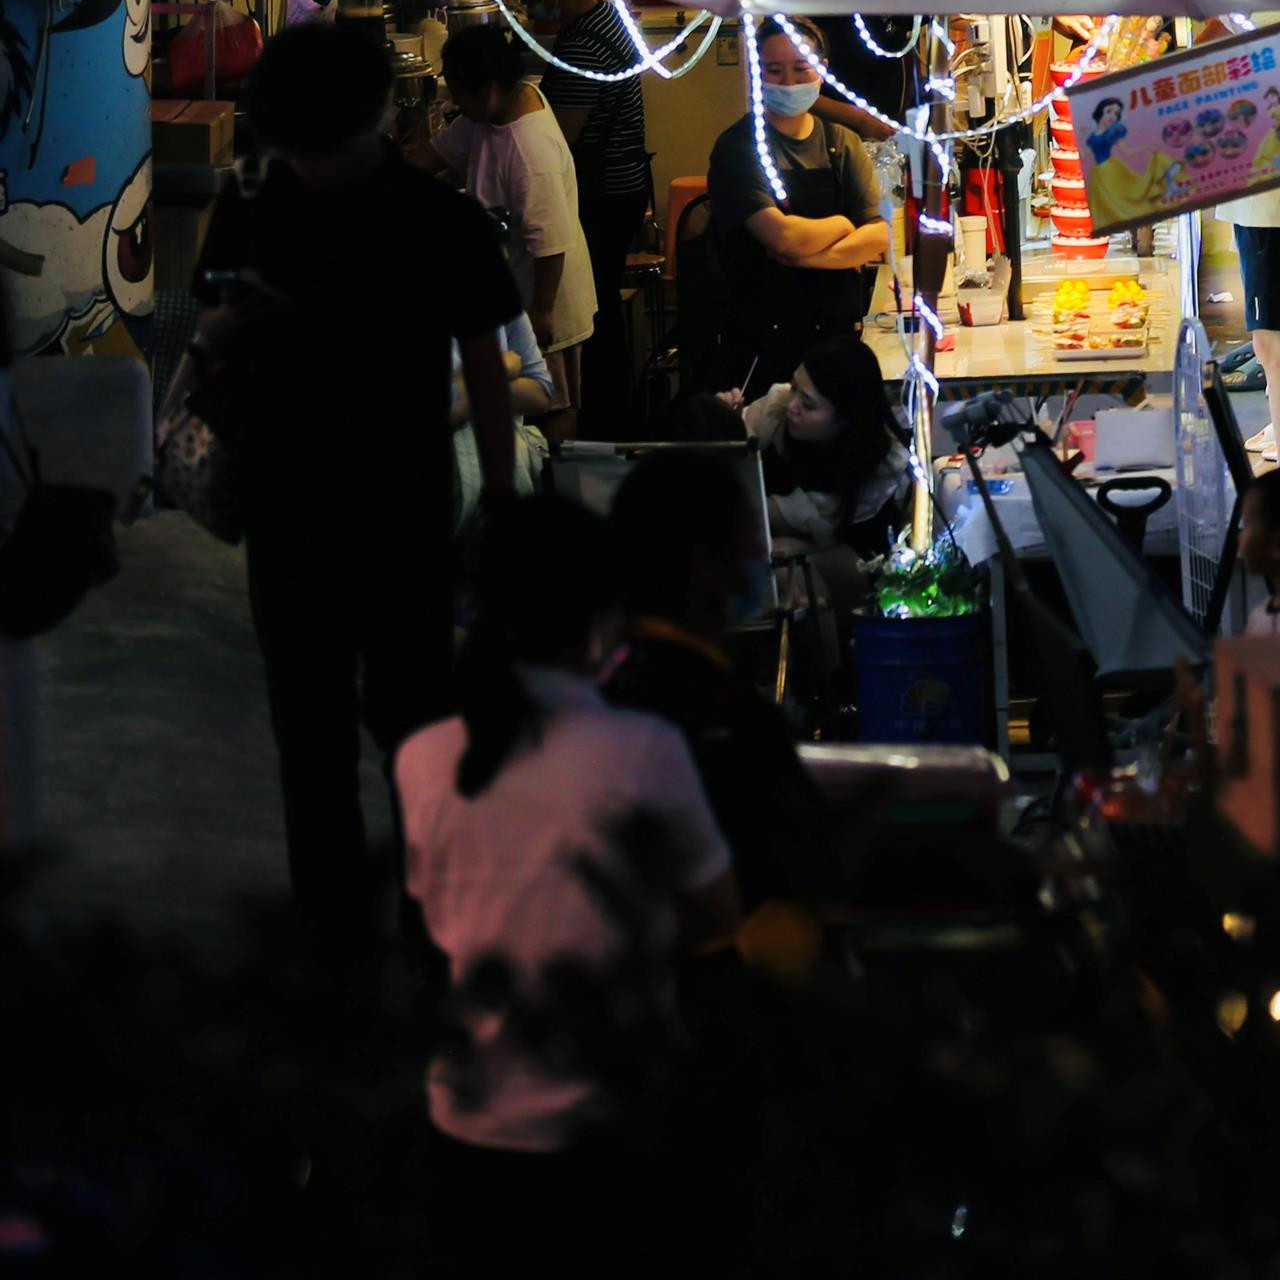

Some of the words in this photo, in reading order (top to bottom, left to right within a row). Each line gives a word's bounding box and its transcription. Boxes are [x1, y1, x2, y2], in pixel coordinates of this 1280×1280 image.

[1130, 47, 1276, 110] 儿童面部彩绘
